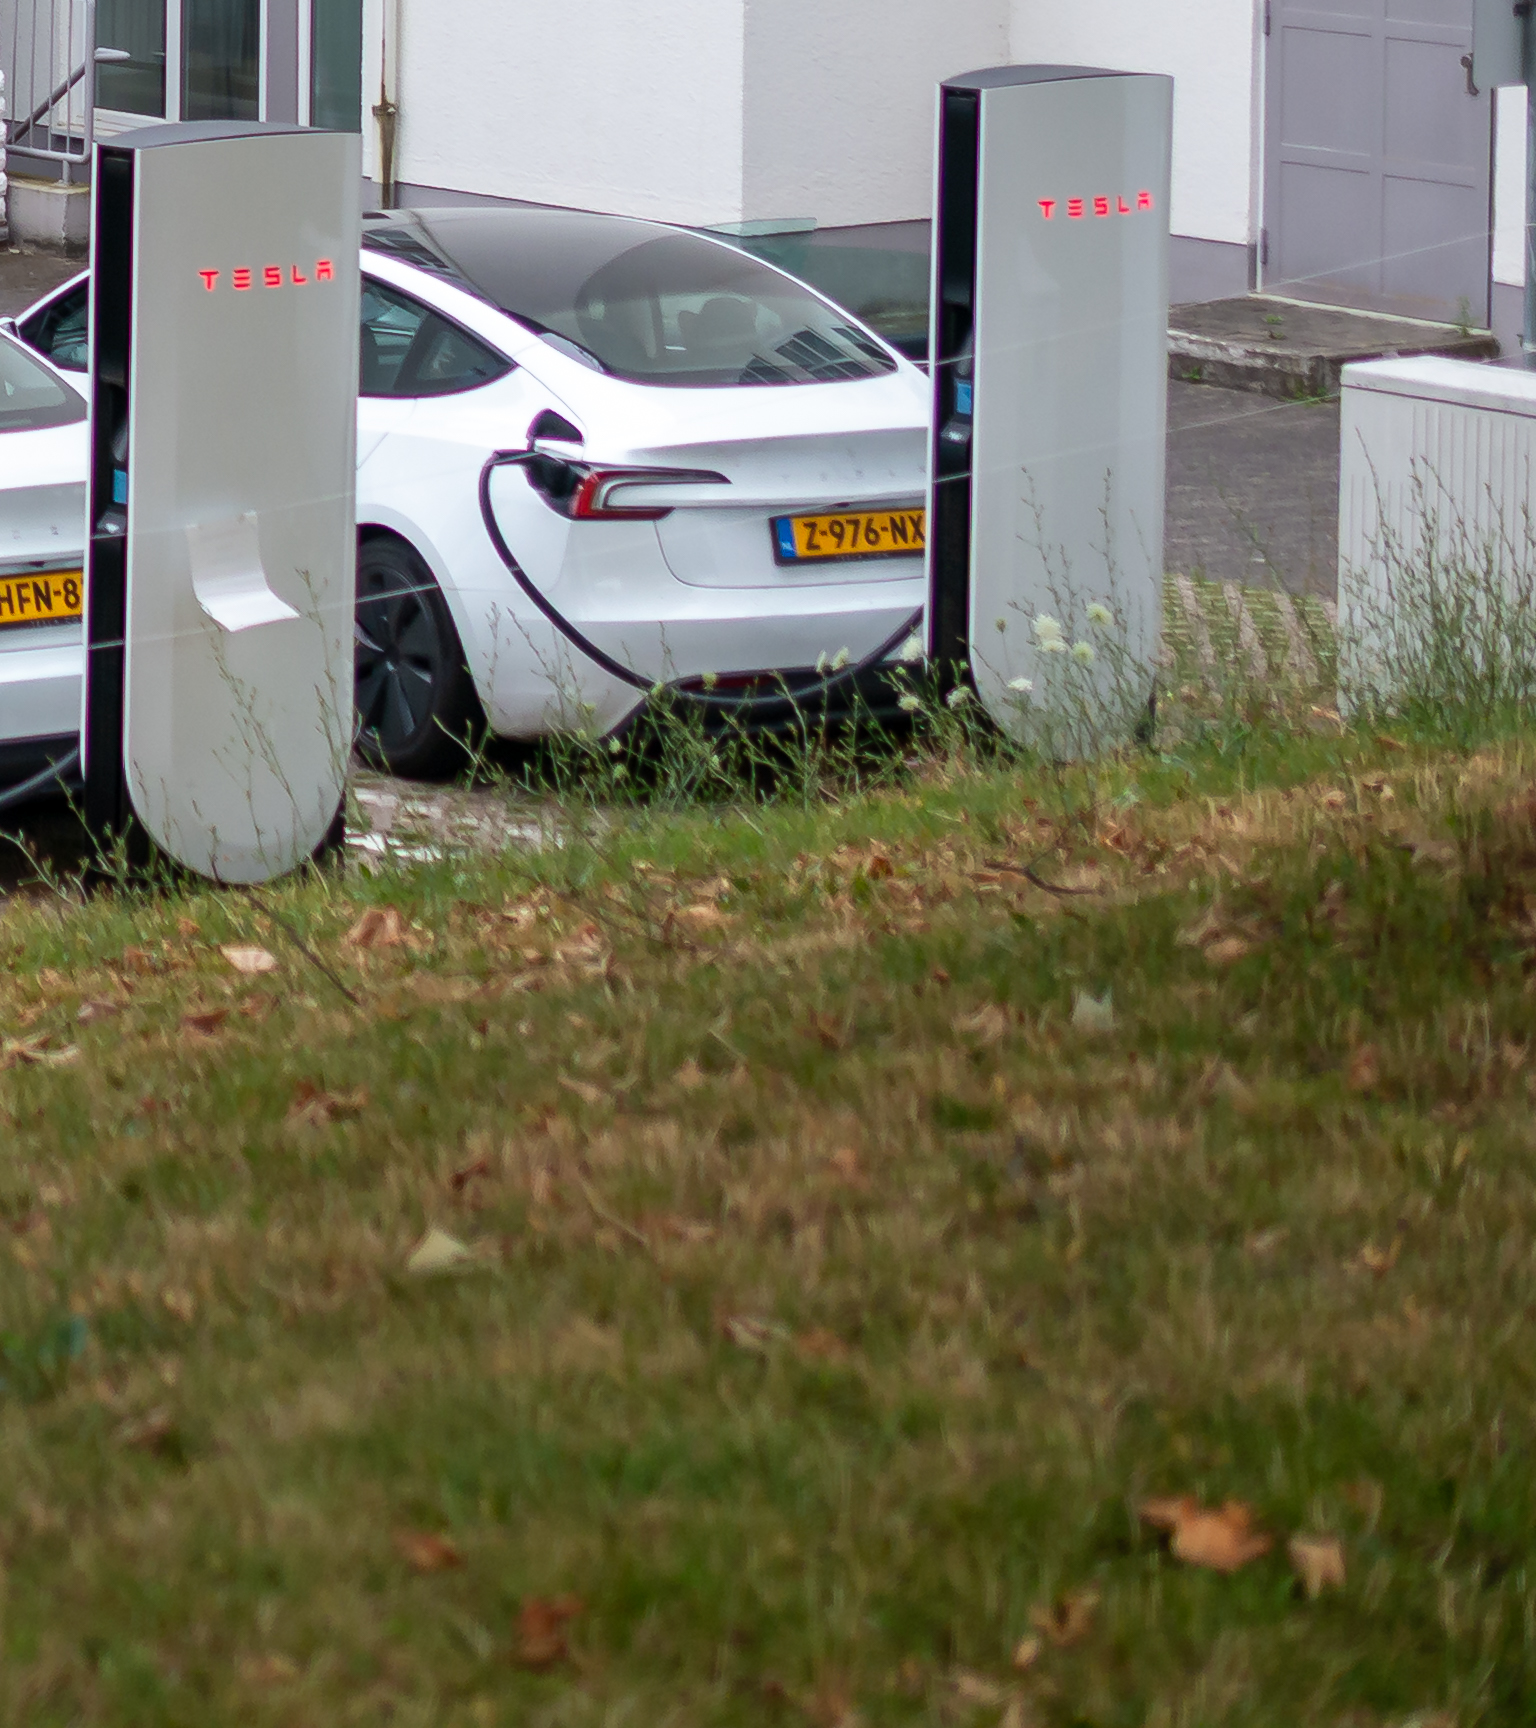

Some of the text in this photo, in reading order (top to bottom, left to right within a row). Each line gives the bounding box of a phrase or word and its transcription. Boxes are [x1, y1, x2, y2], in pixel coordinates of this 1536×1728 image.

[1037, 192, 1150, 219] TESLA
[198, 259, 332, 291] TESLA
[802, 514, 925, 551] Z-976-NX
